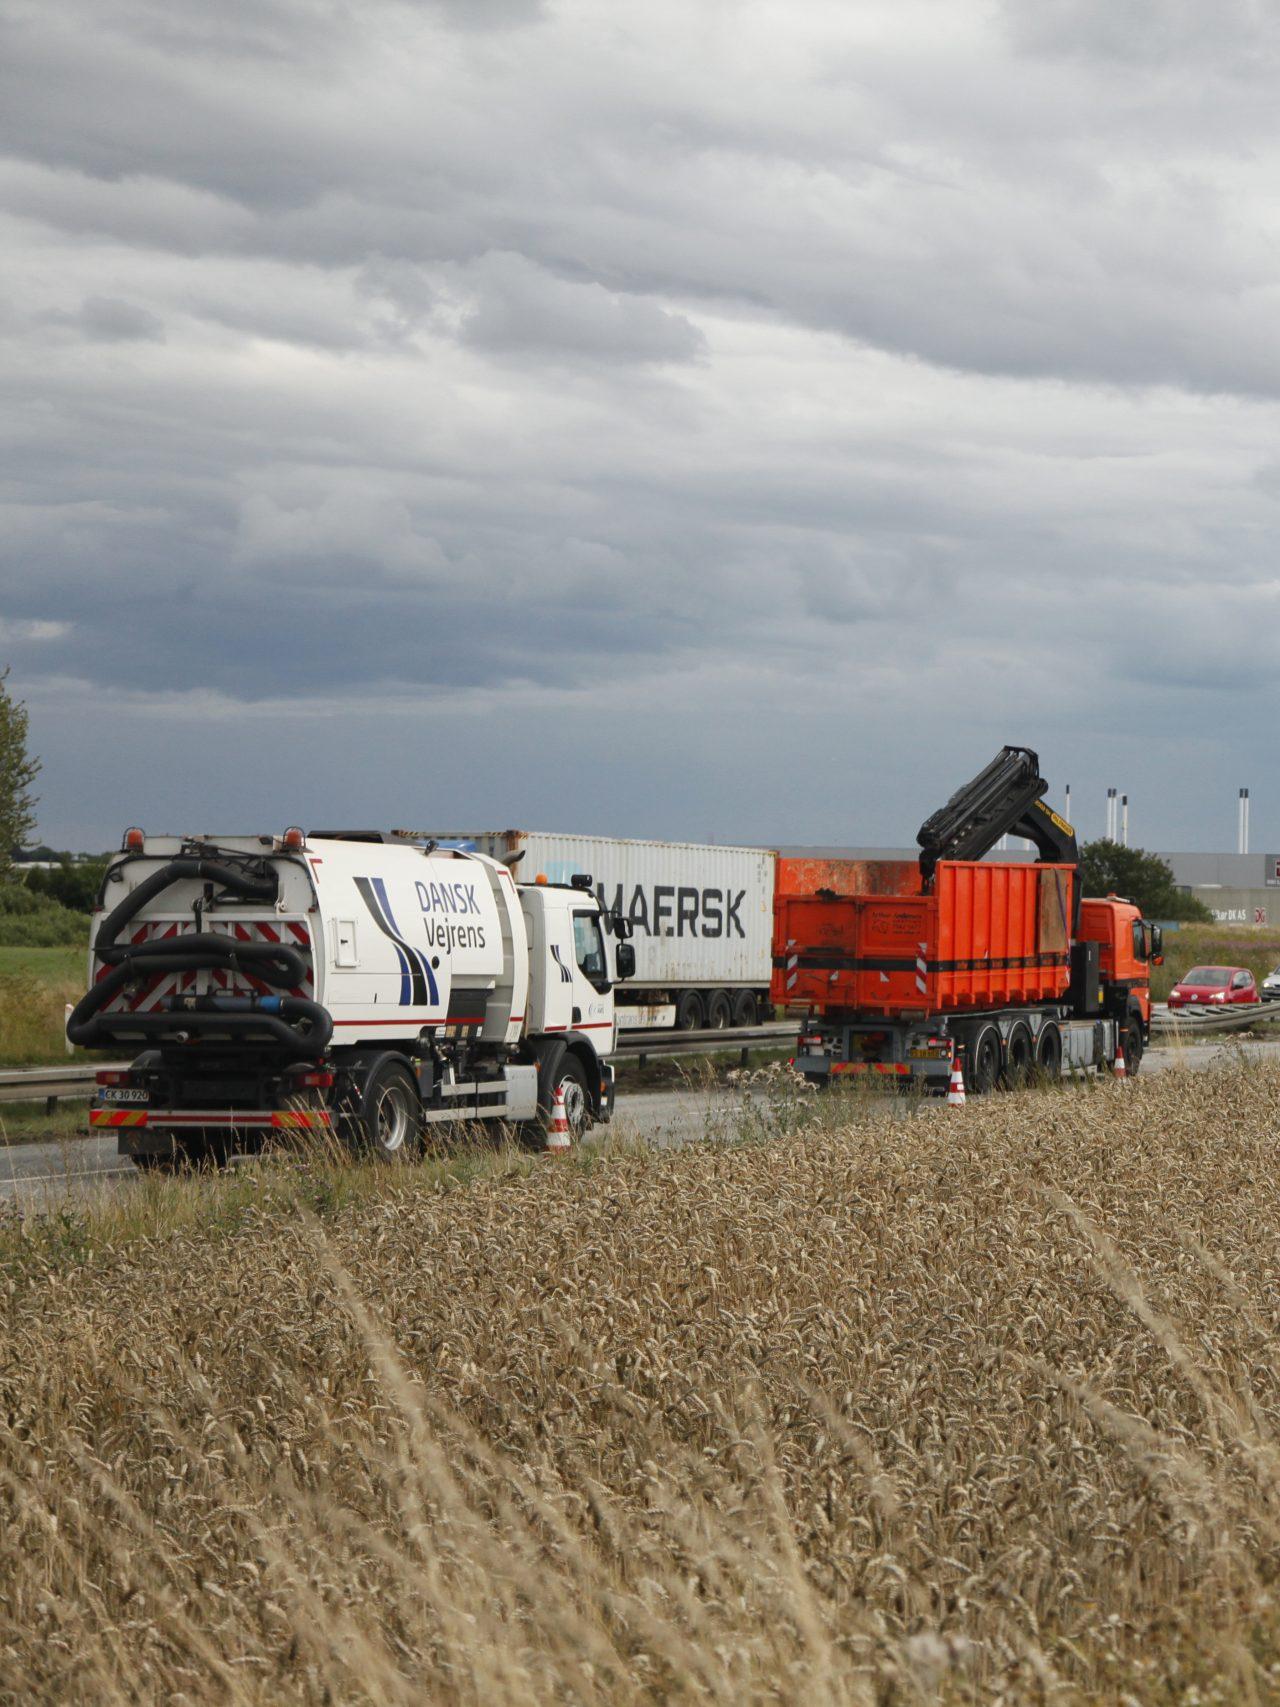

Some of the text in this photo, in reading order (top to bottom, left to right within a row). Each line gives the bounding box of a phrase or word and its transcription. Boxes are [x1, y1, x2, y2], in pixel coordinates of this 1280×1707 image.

[414, 880, 482, 915] DANSK
[597, 883, 747, 939] MAERSK
[423, 917, 486, 955] Vejrens
